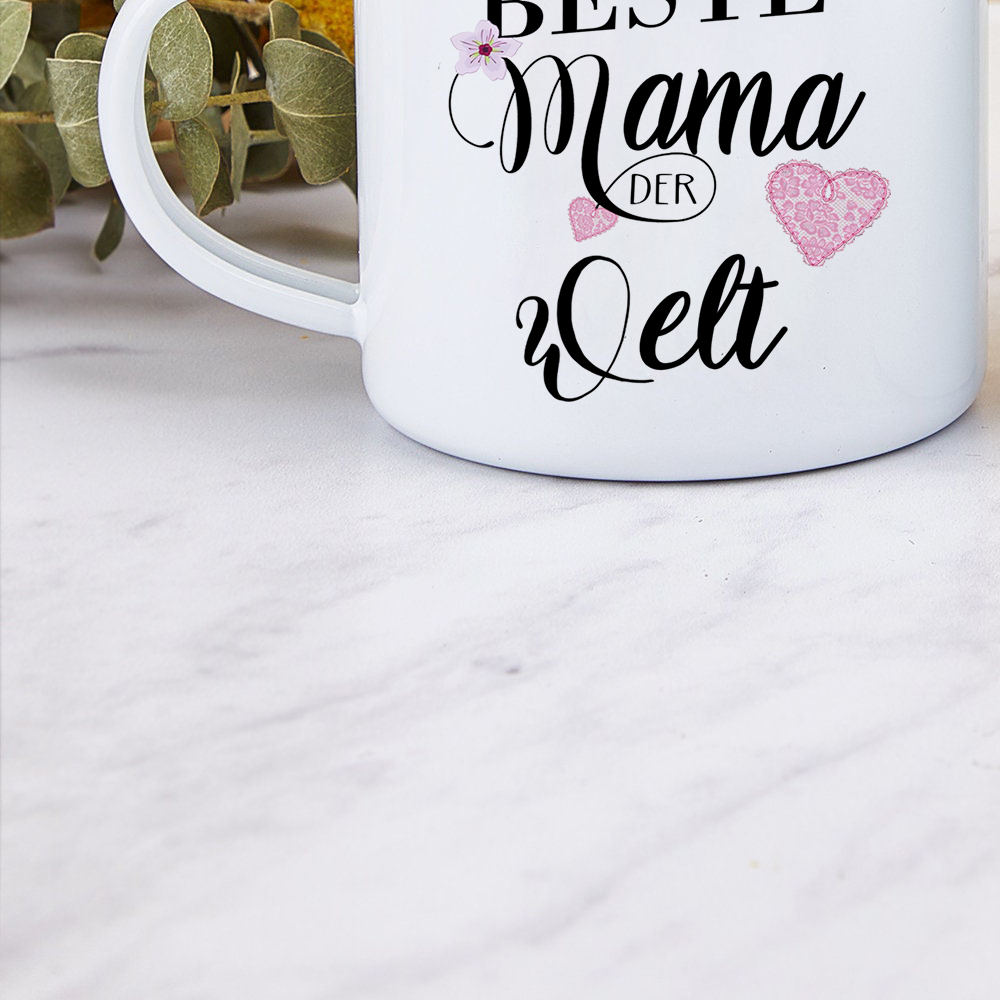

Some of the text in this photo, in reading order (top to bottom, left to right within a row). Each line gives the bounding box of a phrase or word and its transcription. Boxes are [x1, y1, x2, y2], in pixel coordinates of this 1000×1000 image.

[448, 53, 867, 223] Mama
[629, 173, 697, 205] DER
[515, 253, 789, 403] Welt
